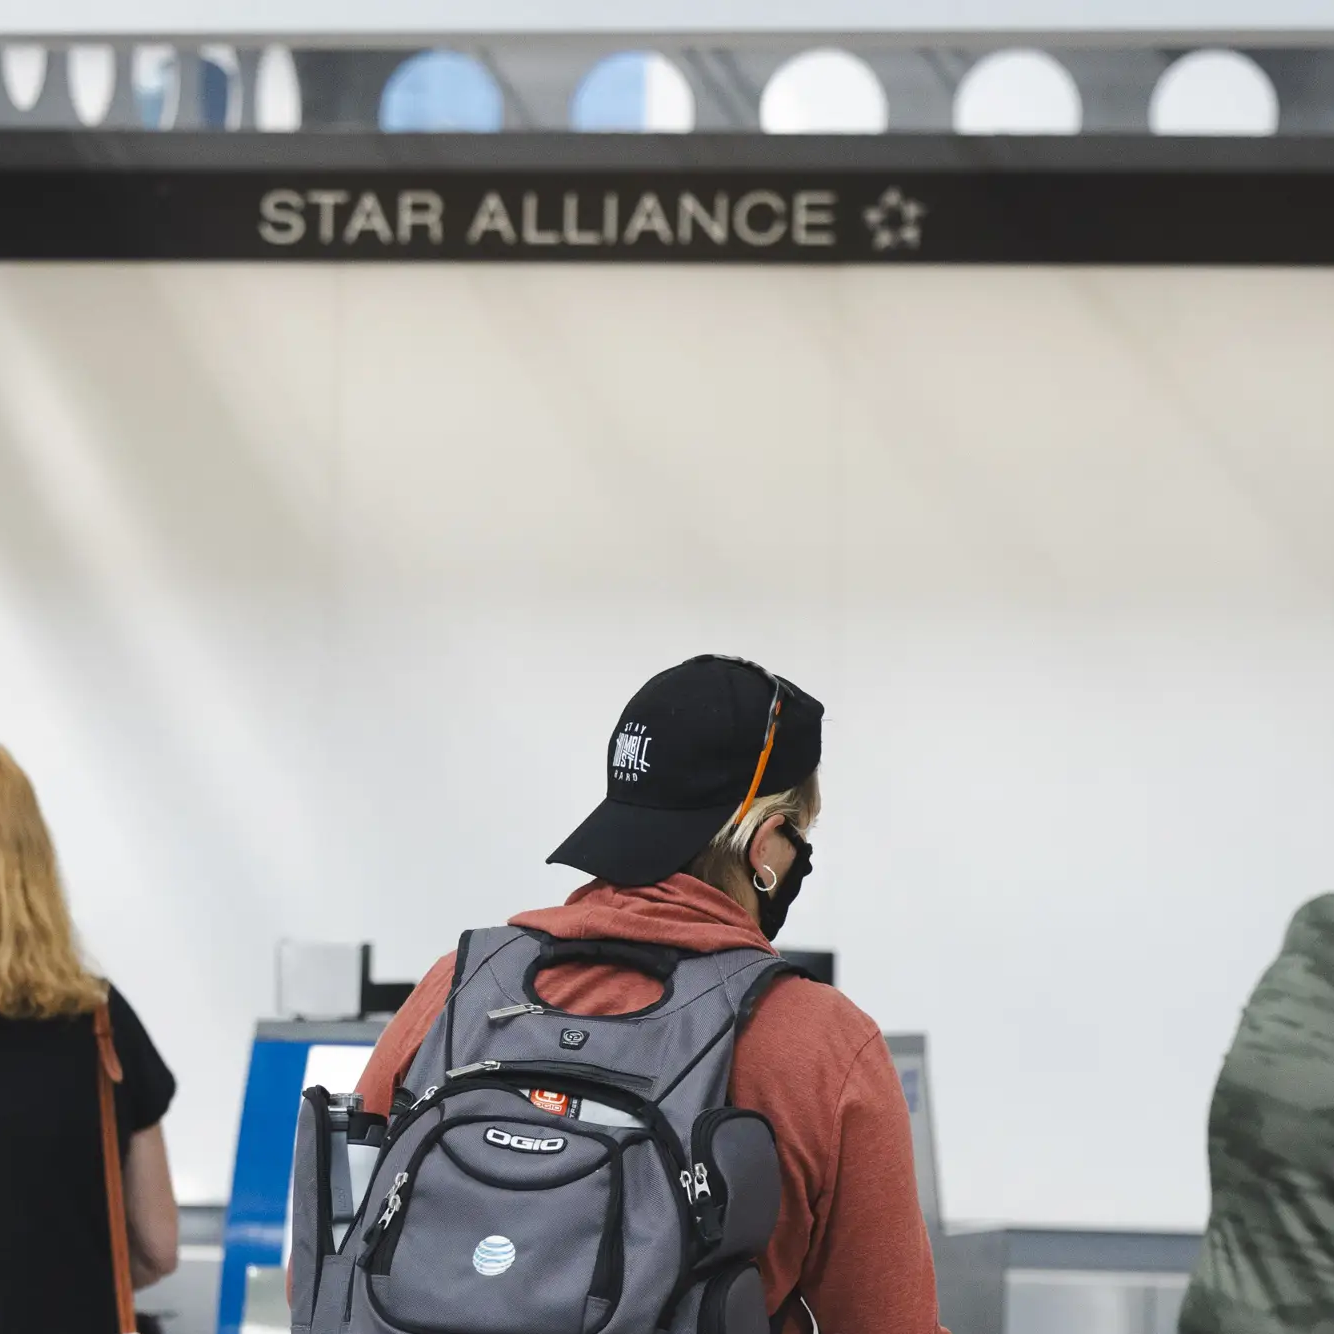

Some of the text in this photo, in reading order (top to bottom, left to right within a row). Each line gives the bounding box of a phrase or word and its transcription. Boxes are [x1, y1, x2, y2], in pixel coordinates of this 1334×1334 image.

[257, 189, 838, 247] STAR ALLIANCE
[624, 722, 647, 735] STAY
[613, 769, 638, 781] HARD
[533, 1101, 562, 1112] OGIO
[486, 1128, 565, 1151] OGIO
